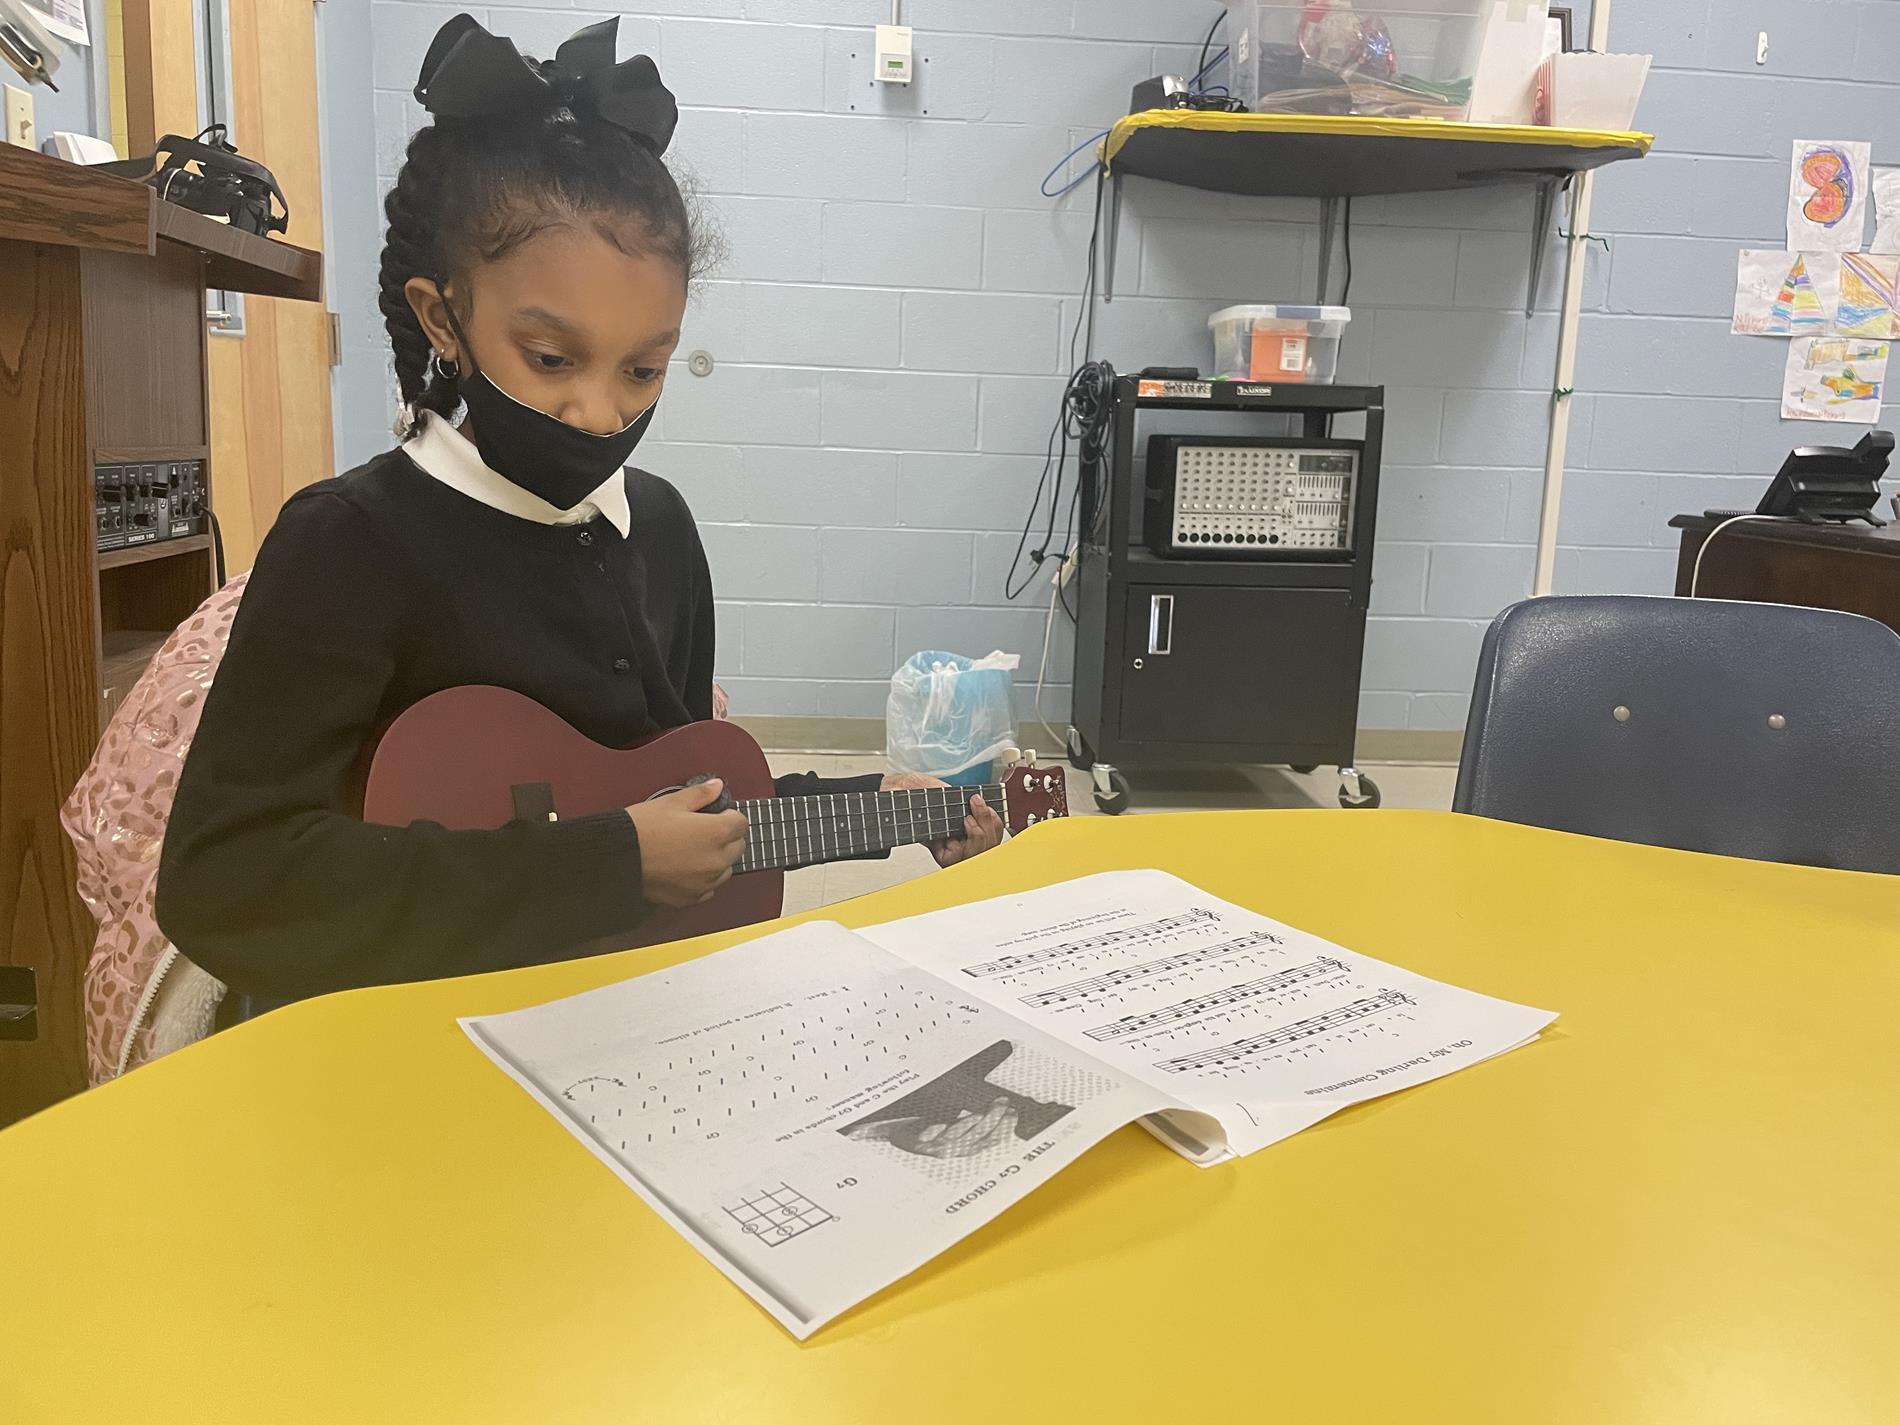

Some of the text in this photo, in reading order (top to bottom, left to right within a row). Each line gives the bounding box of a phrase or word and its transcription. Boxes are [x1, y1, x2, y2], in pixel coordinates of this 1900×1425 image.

[1428, 1048, 1452, 1058] My
[1376, 1057, 1431, 1076] Darling
[1304, 1074, 1379, 1095] Clementine
[1022, 1142, 1056, 1162] THE
[836, 1177, 858, 1189] G7
[945, 1180, 997, 1214] CHORD
